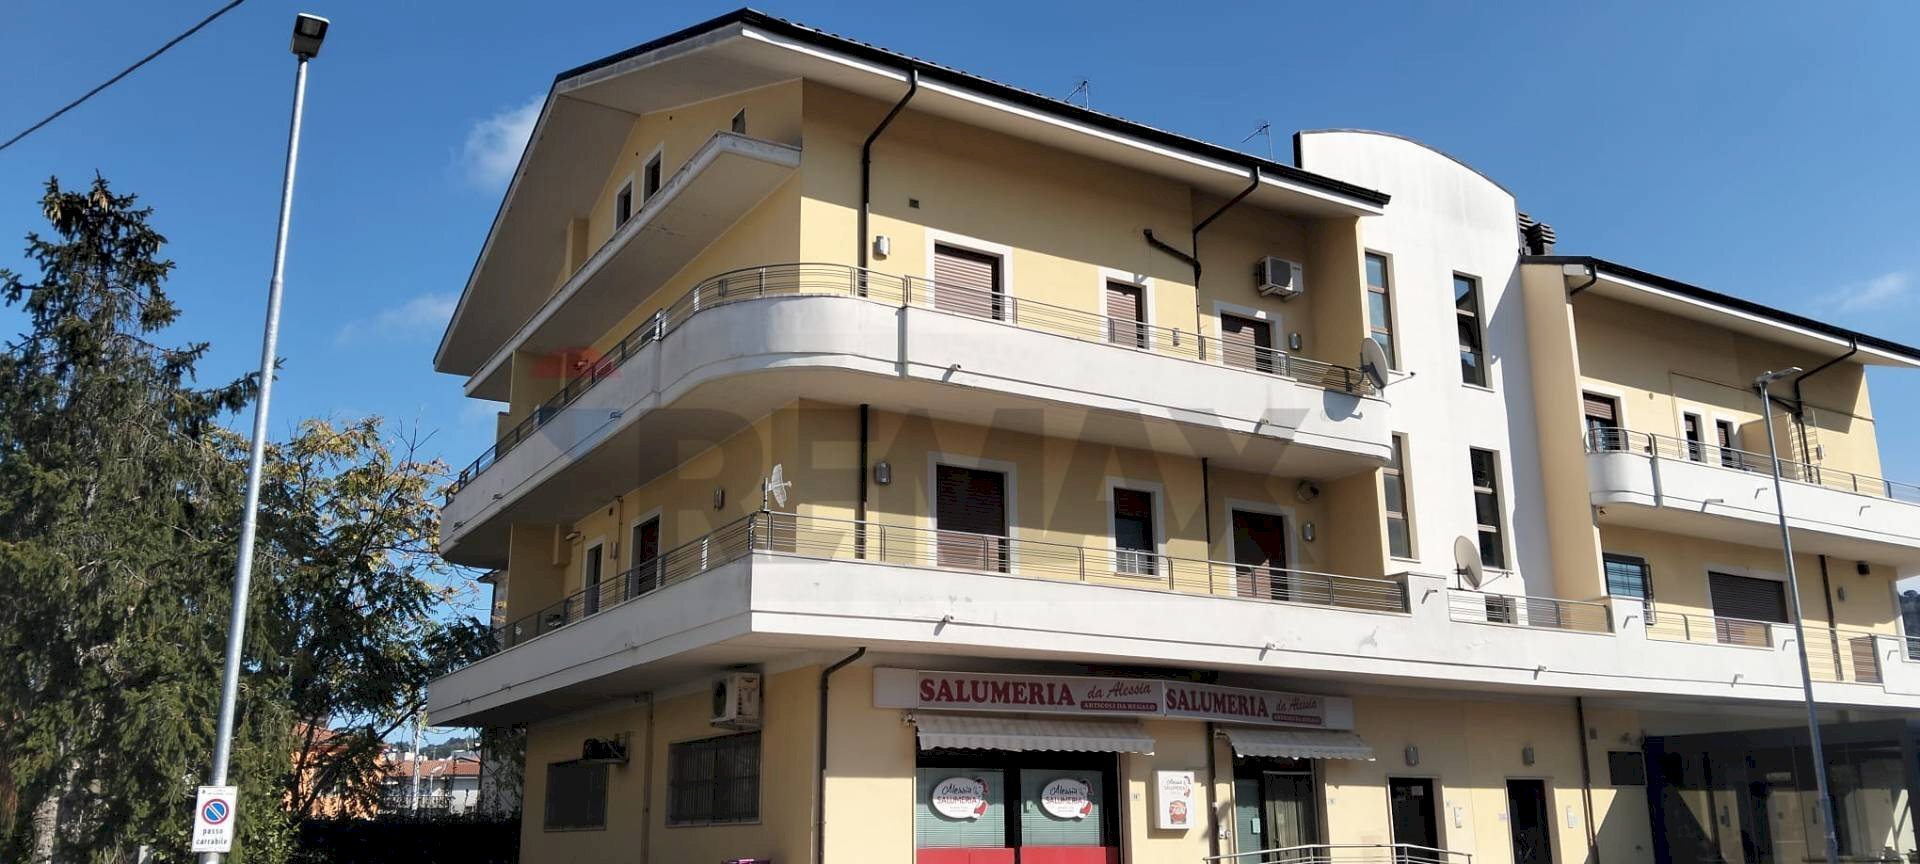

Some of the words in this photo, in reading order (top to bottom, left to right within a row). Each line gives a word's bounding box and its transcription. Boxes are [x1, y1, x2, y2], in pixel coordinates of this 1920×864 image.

[919, 678, 1075, 706] SALUMERIA
[1087, 685, 1104, 699] da
[1106, 681, 1152, 698] Alessia
[1084, 702, 1116, 710] ARTICOLI
[1166, 688, 1269, 718] SALUMERIA
[203, 828, 224, 836] passo
[195, 837, 228, 845] carrabile
